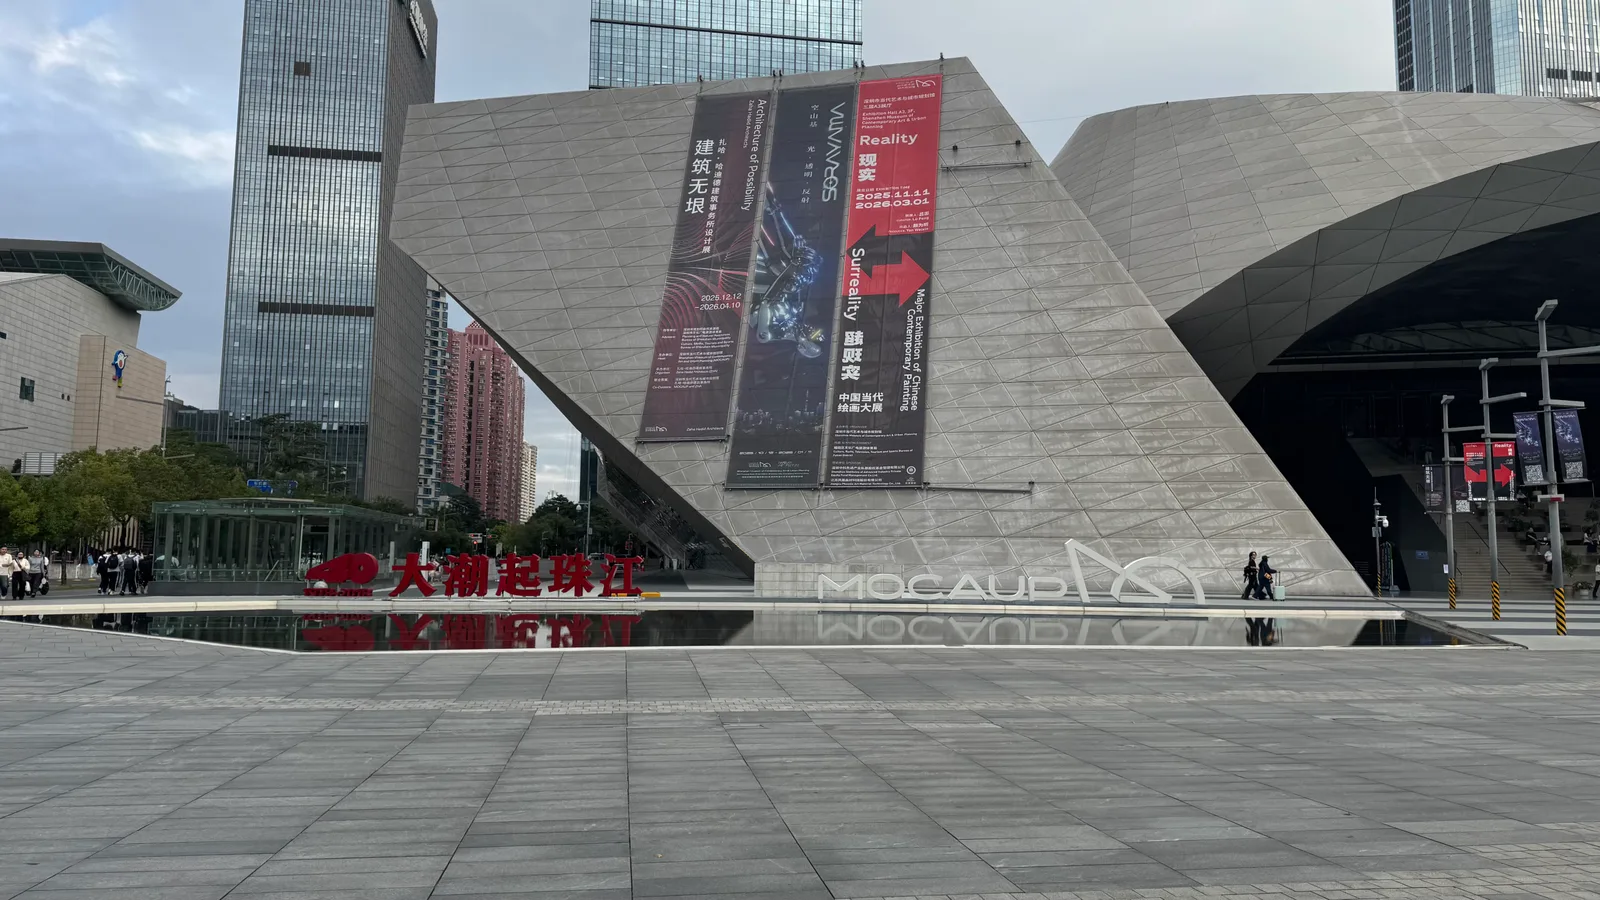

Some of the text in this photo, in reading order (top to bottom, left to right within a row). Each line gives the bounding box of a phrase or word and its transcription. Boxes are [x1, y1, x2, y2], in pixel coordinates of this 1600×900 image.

[860, 133, 919, 146] Reality
[741, 99, 767, 211] Architecture of Possibility
[857, 153, 877, 182] 现实
[684, 139, 715, 215] 建筑无垠
[855, 197, 930, 209] 2026.03.01
[856, 188, 931, 201] 2025.11.11
[701, 293, 742, 302] 2025.12.12
[843, 248, 865, 321] Surreality
[900, 308, 916, 412] Contemporary Painting
[910, 288, 925, 411] Major Exhibition of Chinese
[837, 402, 883, 413] 绘画大展
[838, 392, 884, 403] 中国当代
[388, 552, 644, 598] 大潮起珠江
[817, 573, 1069, 602] MOCAUP
